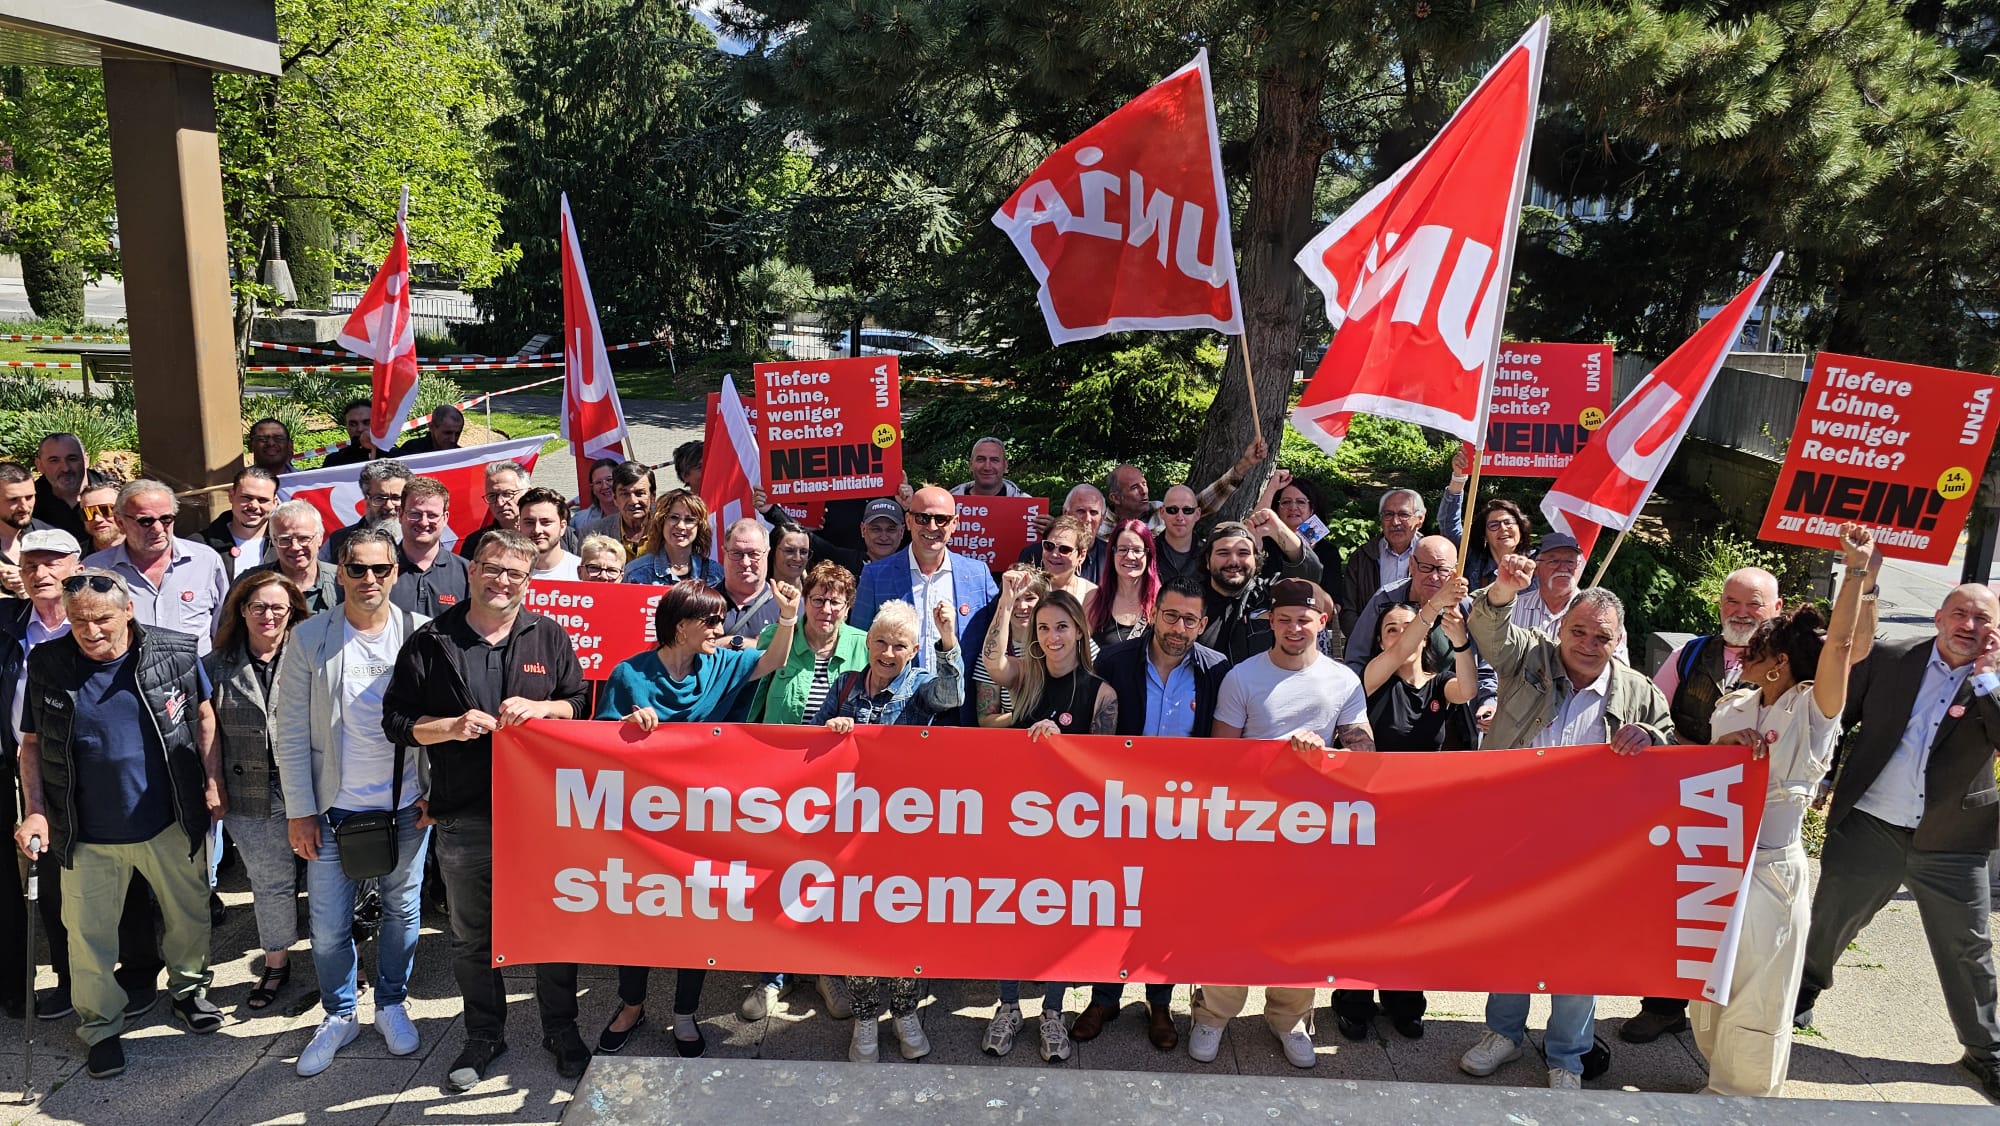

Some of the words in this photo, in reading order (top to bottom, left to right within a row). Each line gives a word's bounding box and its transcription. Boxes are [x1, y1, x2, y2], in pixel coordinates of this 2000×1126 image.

[1497, 351, 1542, 365] efere
[764, 371, 830, 387] Tiefere
[1495, 367, 1538, 384] hne,
[1826, 367, 1912, 397] Tiefere
[766, 389, 829, 405] Löhne,
[1492, 383, 1549, 400] eniger
[767, 407, 841, 423] weniger
[1490, 401, 1551, 415] echte?
[1816, 391, 1900, 424] Löhne,
[1585, 418, 1601, 426] Juni
[768, 423, 844, 441] Rechte?
[877, 428, 890, 436] 14.
[877, 434, 893, 444] Juni
[1485, 421, 1589, 454] NEIN!
[1811, 419, 1910, 447] weniger
[770, 443, 884, 481] NEIN!
[1801, 440, 1906, 471] Rechte?
[772, 483, 791, 495] zur
[793, 476, 884, 494] Chaos-Initiative
[1946, 473, 1964, 483] 14.
[1942, 483, 1965, 493] Juni
[955, 503, 988, 516] fere
[1784, 470, 1946, 532] NEIN!
[1776, 515, 1805, 532] zur
[947, 534, 995, 549] eniger
[555, 768, 983, 835] Menschen
[1008, 779, 1376, 846] schützen
[552, 857, 755, 922] statt
[779, 859, 1144, 928] Grenzen!
